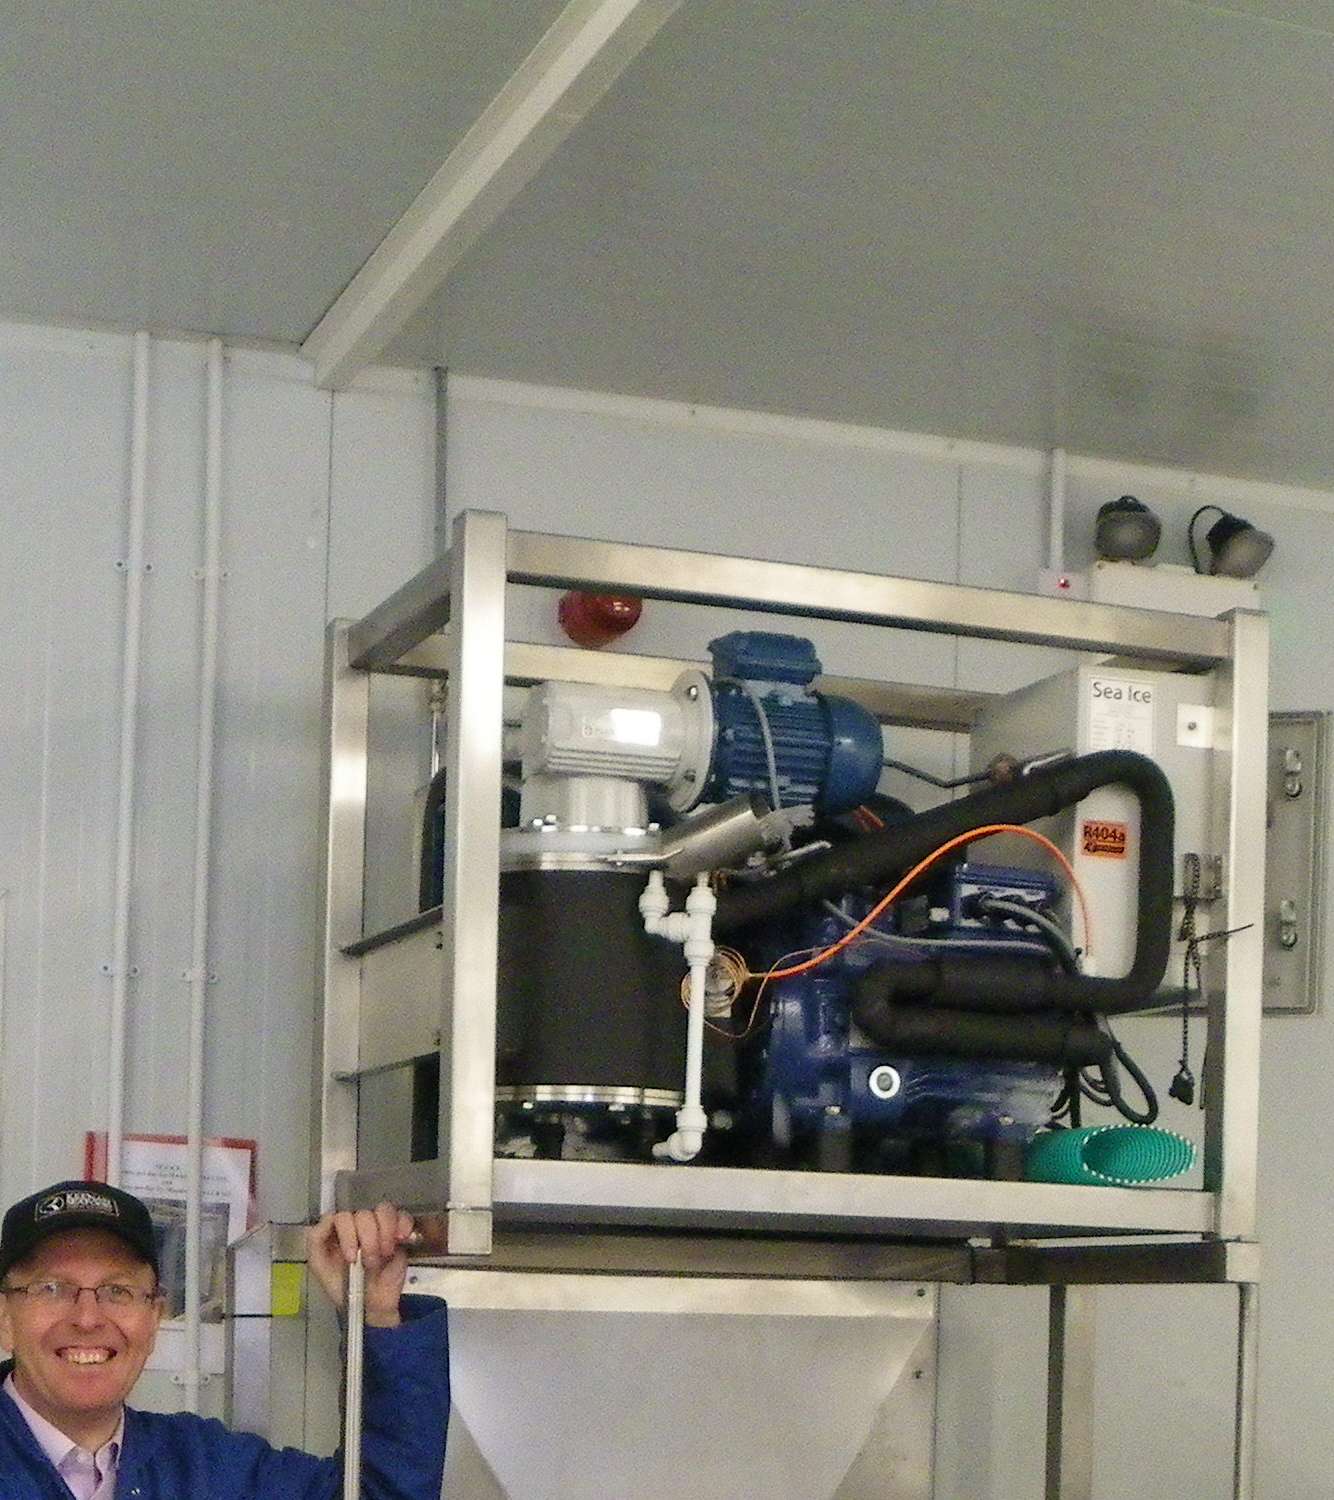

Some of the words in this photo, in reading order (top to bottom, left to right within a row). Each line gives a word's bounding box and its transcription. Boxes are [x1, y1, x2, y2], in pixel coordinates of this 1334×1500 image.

[1093, 681, 1123, 700] Sea
[1128, 684, 1152, 704] Ice
[1083, 824, 1126, 842] R404a
